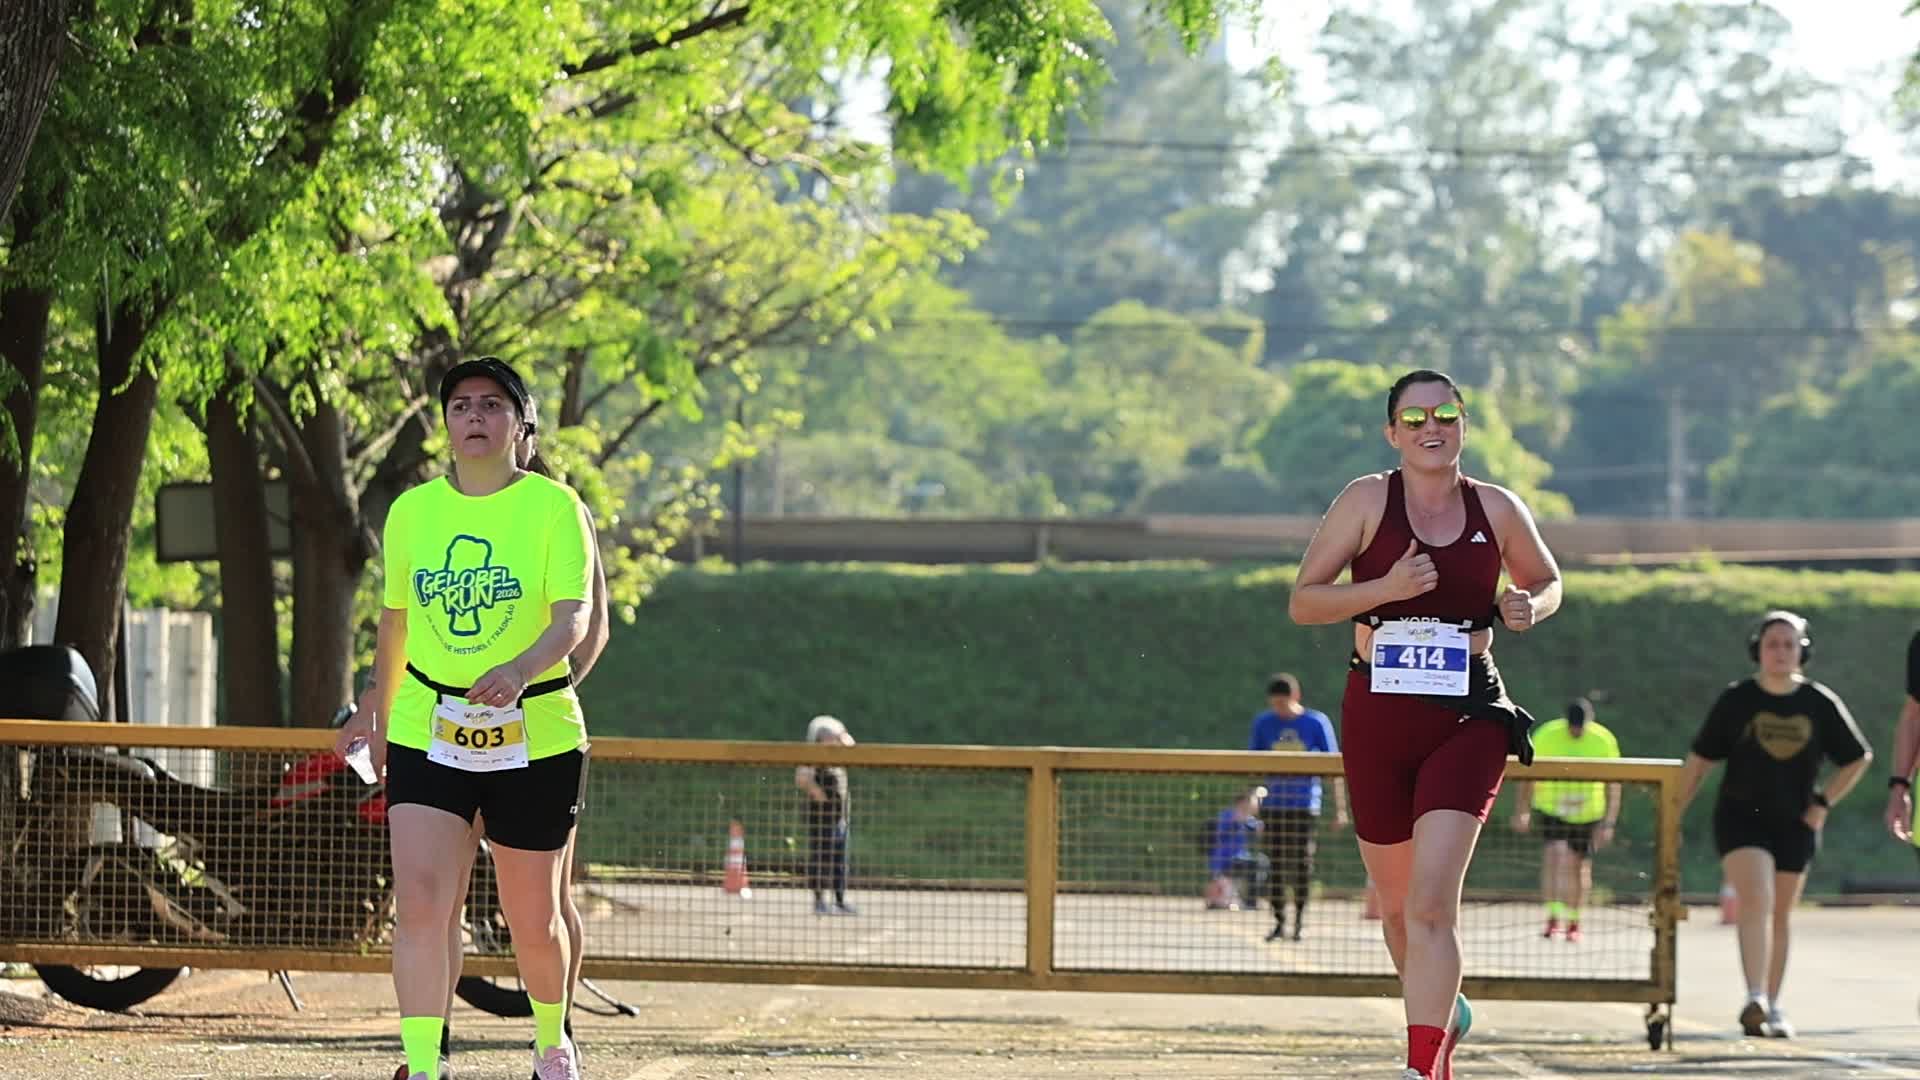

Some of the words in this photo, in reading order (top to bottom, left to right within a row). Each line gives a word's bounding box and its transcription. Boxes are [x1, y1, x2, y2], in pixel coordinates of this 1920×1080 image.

[421, 568, 518, 596] GELOBEL
[495, 588, 521, 600] 2026
[442, 583, 494, 615] RUN
[1398, 646, 1446, 670] 414
[454, 726, 505, 749] 603
